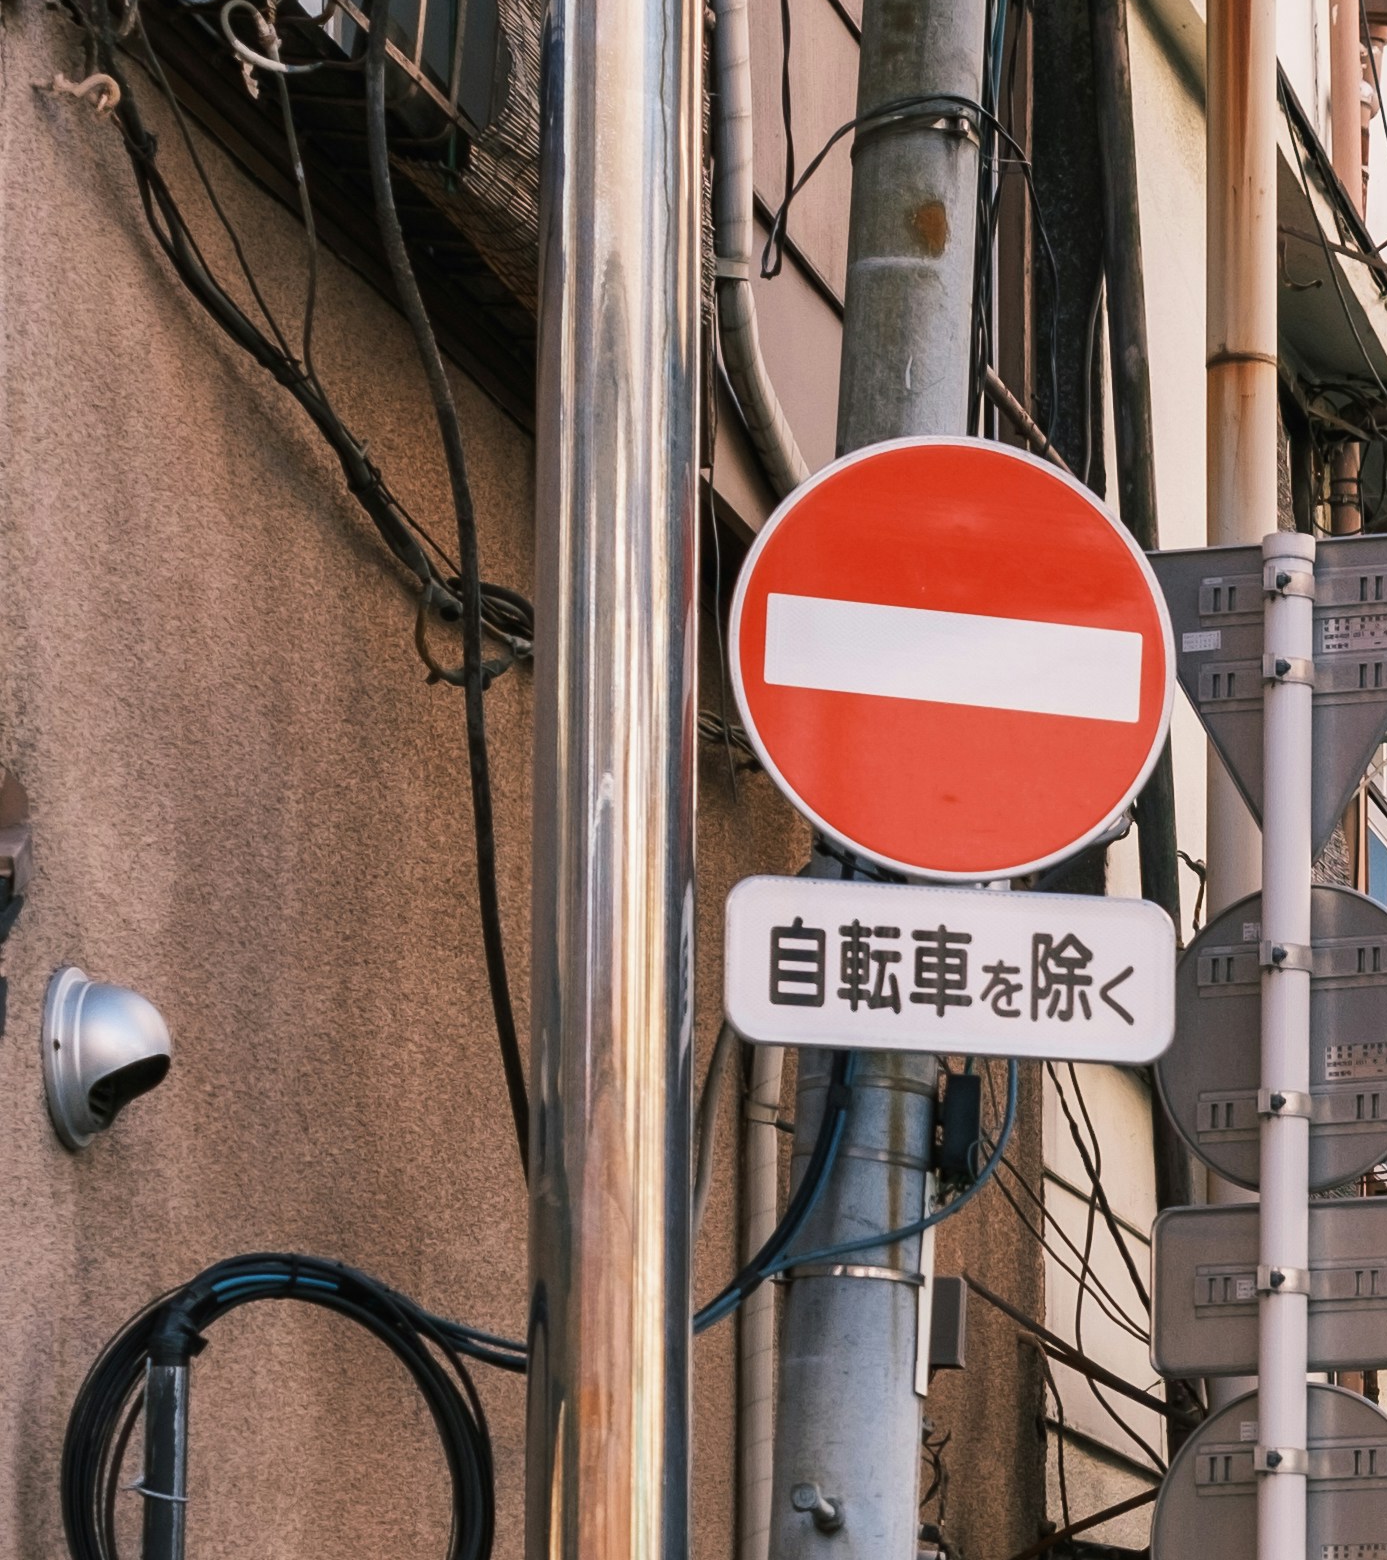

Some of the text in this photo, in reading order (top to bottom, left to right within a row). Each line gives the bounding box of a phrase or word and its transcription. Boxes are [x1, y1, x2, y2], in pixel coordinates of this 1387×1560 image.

[768, 916, 1136, 1027] 自転車を除く
